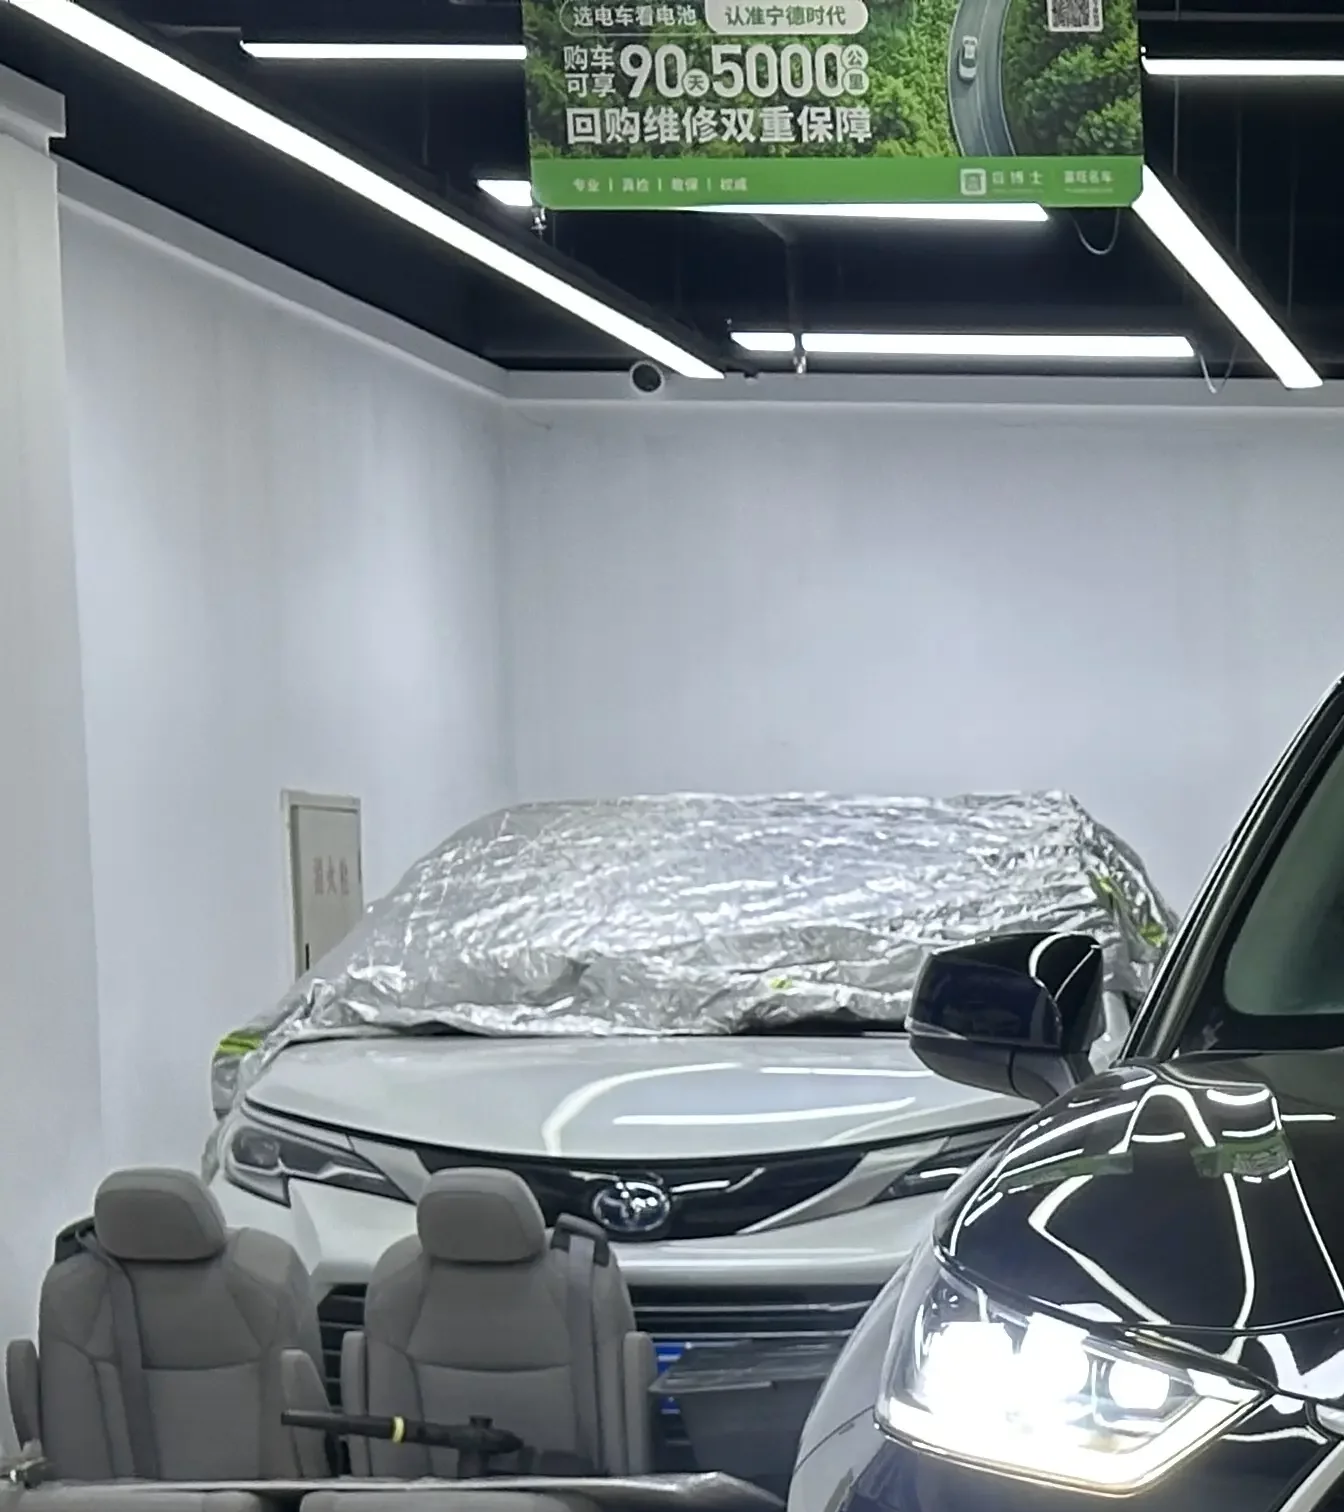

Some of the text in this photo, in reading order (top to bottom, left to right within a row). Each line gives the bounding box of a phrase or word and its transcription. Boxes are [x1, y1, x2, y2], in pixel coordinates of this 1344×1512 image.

[573, 5, 847, 27] 选电车看电池 认准宁德时代
[563, 45, 615, 71] 购车
[564, 73, 616, 97] 可享
[565, 105, 873, 145] 回购维修双重保障
